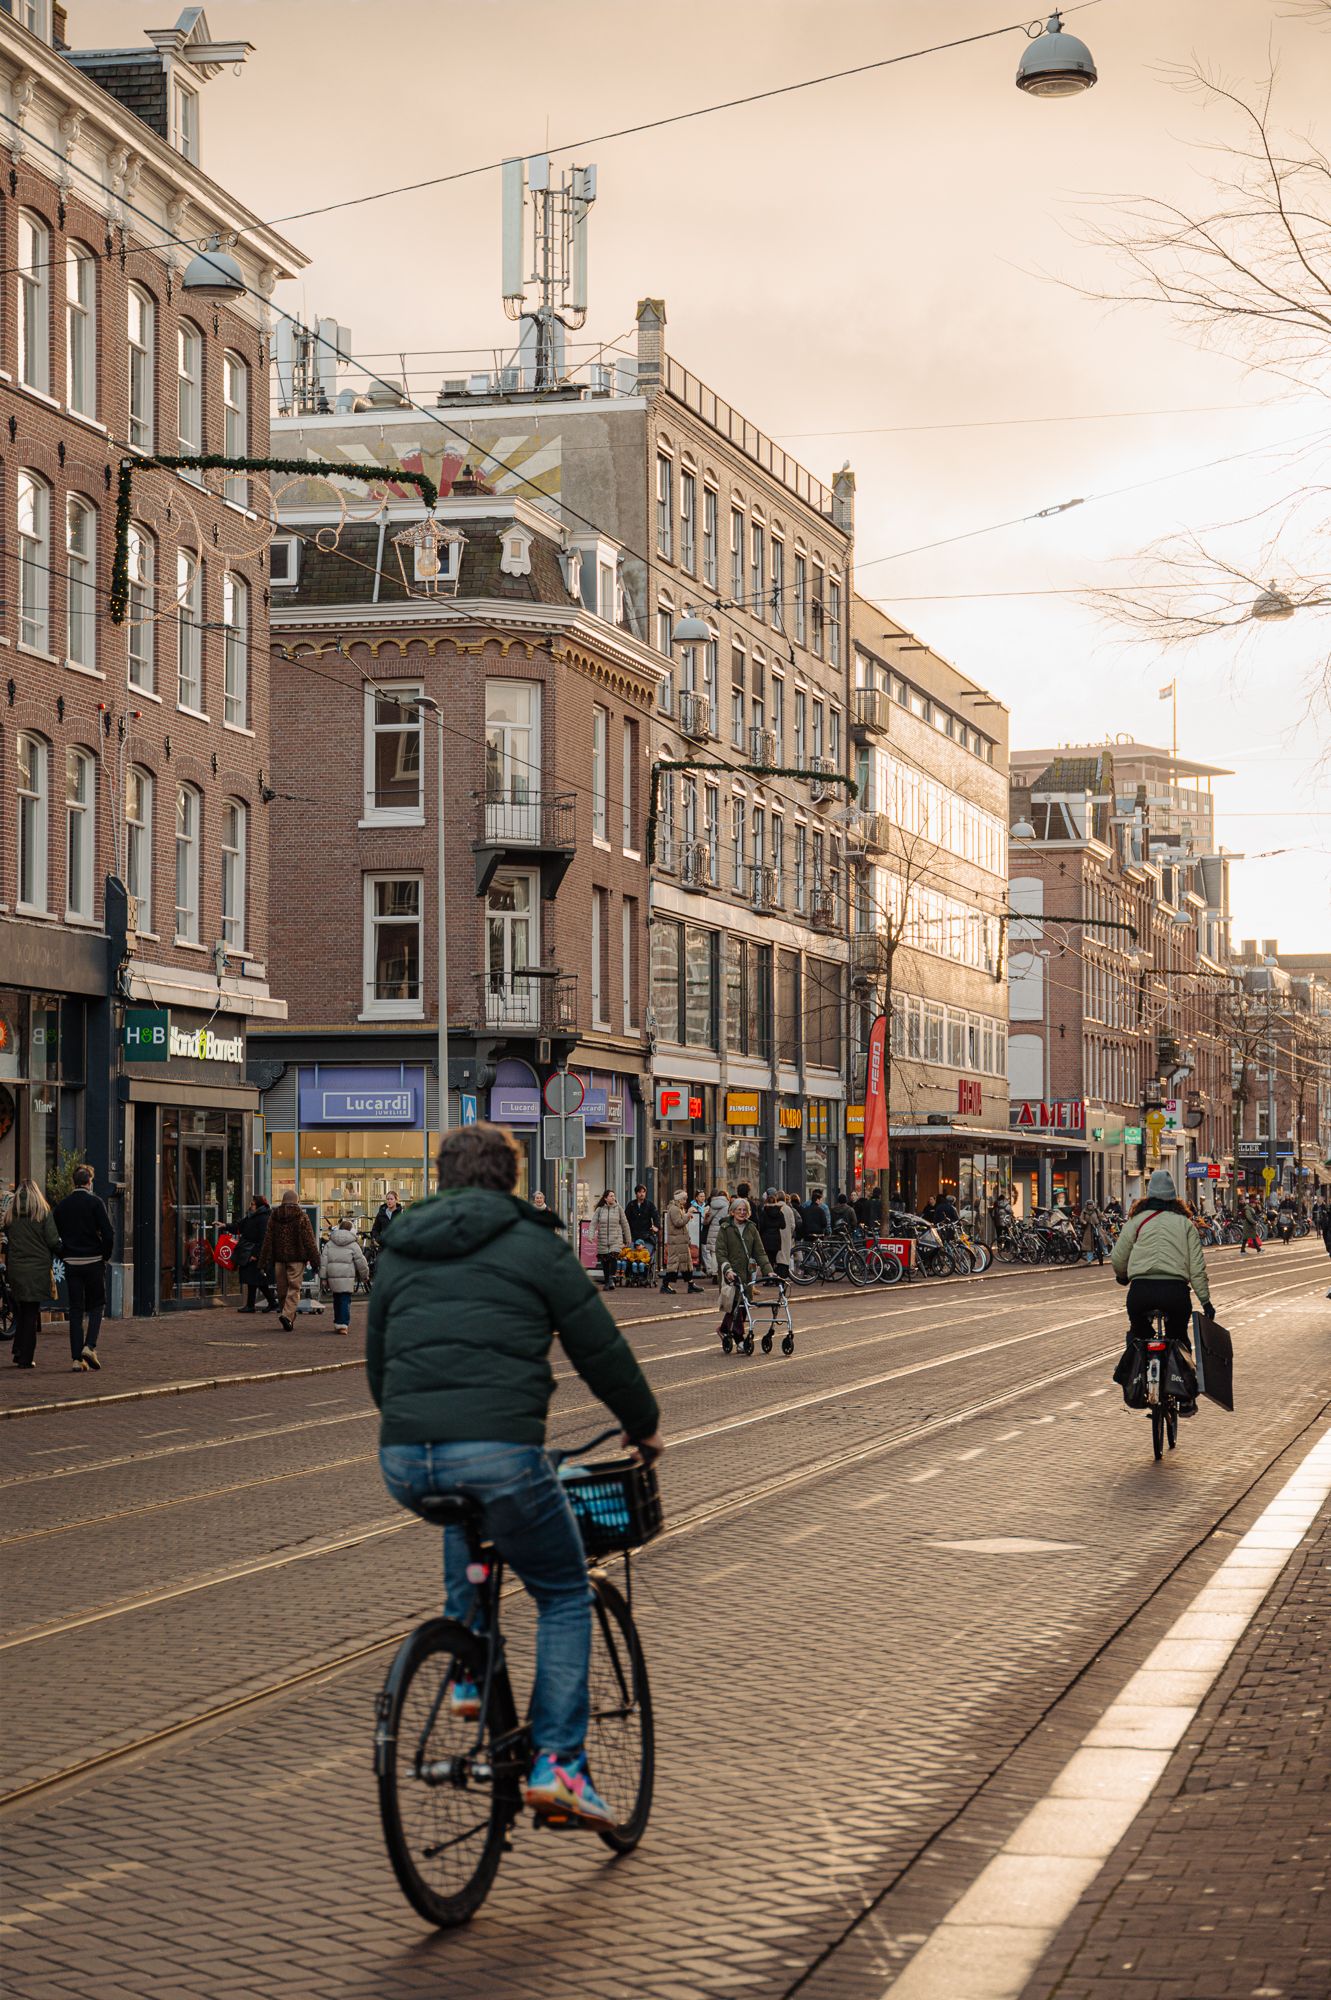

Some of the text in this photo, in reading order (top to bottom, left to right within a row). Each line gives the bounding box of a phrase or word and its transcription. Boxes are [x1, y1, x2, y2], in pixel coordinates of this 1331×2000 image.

[127, 1027, 165, 1044] H&B
[871, 1041, 881, 1095] FEBO
[346, 1096, 407, 1110] Lucardi
[510, 1103, 537, 1111] Lucardi
[661, 1091, 680, 1116] F
[959, 1079, 981, 1116] HEMA
[779, 1106, 802, 1129] JUMBO
